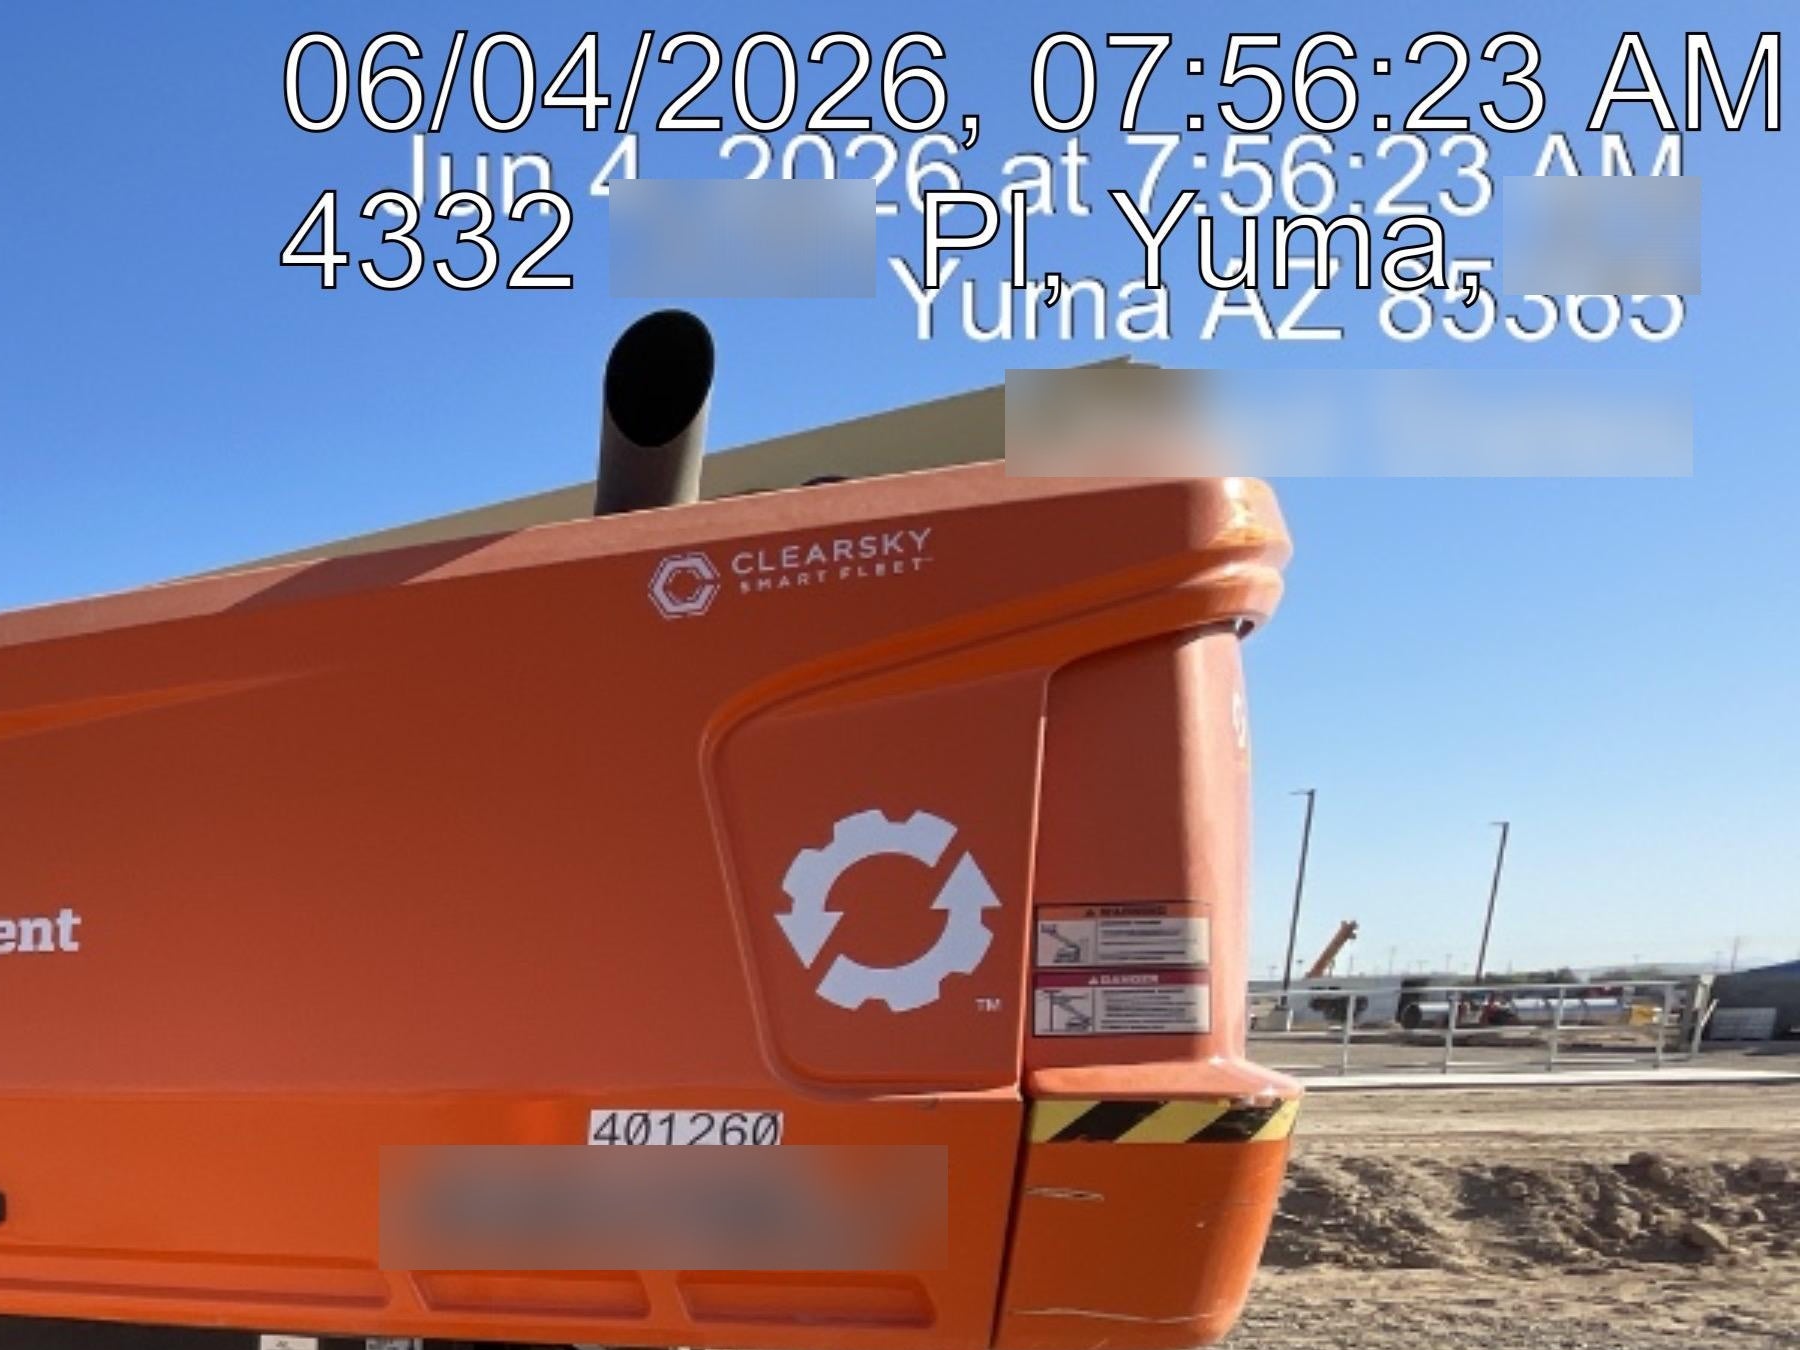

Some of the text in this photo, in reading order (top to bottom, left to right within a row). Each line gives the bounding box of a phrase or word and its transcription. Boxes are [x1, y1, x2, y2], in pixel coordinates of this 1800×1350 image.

[731, 527, 932, 574] CLEARSKY
[740, 557, 923, 593] SMART FLEET
[592, 1111, 782, 1146] 401260
